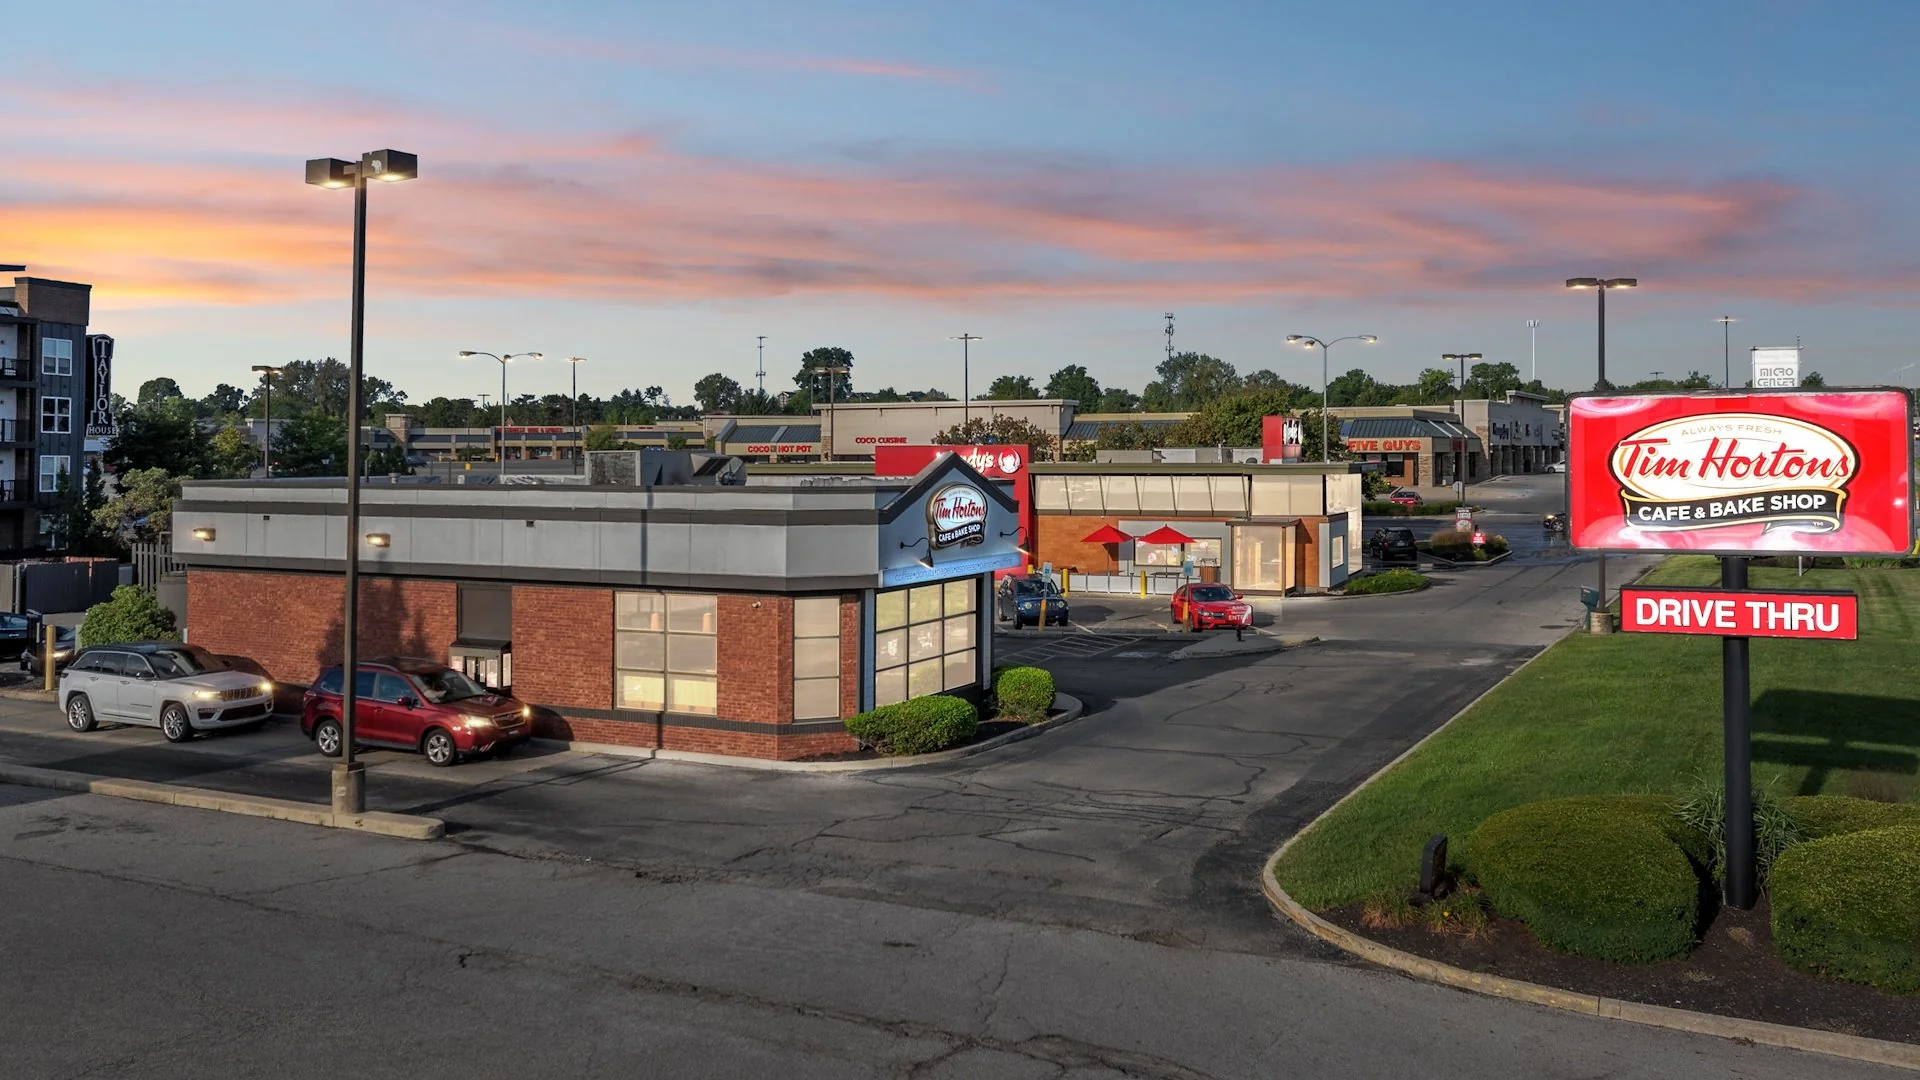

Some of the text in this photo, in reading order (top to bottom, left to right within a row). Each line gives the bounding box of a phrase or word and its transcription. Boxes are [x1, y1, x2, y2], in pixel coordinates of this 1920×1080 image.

[1760, 368, 1794, 377] MICRO
[97, 338, 110, 425] TAYLOR
[1757, 378, 1795, 387] CENTER
[89, 426, 116, 435] HOUSE
[1681, 424, 1782, 436] ALWAYS FRESH
[855, 436, 907, 444] COCO CUISINE
[1348, 439, 1421, 452] FIVE GUYS
[748, 445, 812, 453] COCO HOT POT
[1620, 437, 1850, 479] Tim Hortons
[934, 497, 985, 519] Tim Hortons
[1638, 494, 1826, 521] CAFE & BAKE SHOP
[938, 533, 951, 541] CAFE
[955, 526, 968, 538] BAKE
[968, 524, 980, 533] SHOP
[1636, 598, 1840, 631] DRIVE THRU
